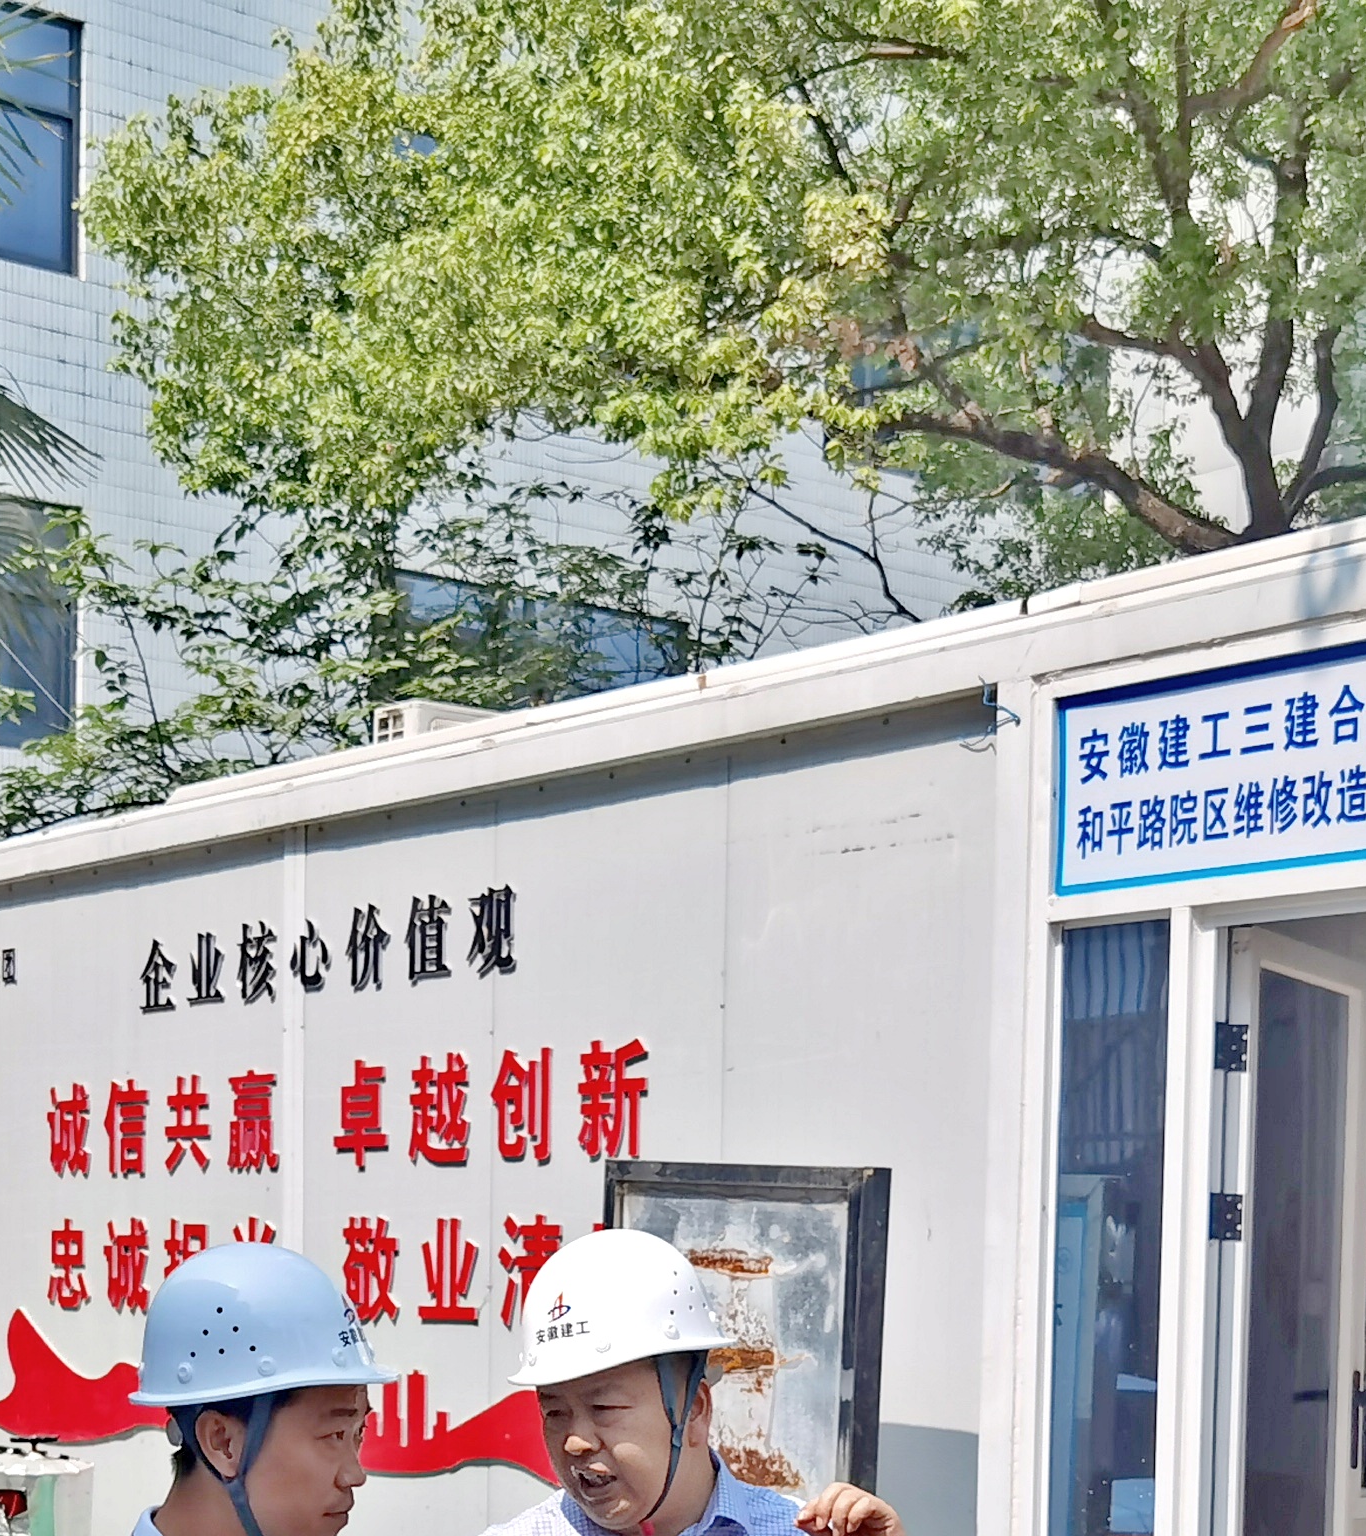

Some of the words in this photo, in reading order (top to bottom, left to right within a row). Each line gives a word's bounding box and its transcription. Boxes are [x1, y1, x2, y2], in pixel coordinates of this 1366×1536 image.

[139, 883, 517, 1014] 企业核心价值观
[46, 1069, 279, 1178] 诚信共赢
[333, 1038, 649, 1171] 卓越创新
[342, 1213, 607, 1331] 敬业清
